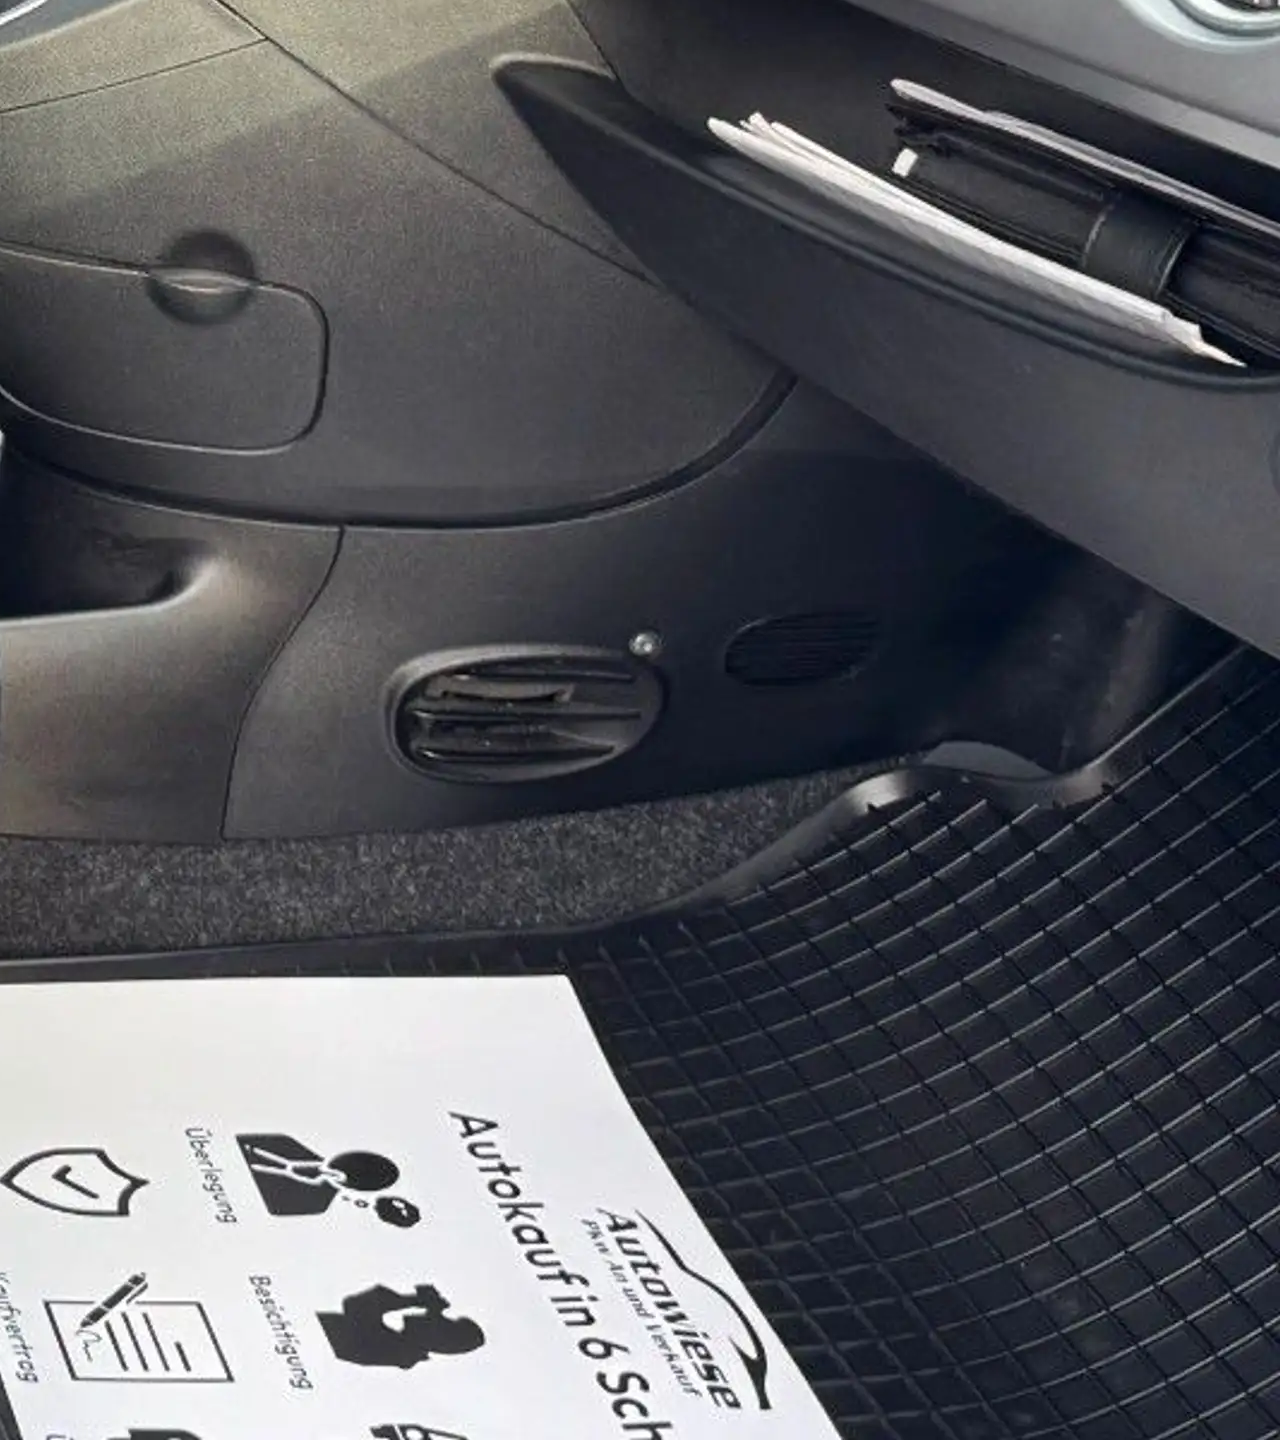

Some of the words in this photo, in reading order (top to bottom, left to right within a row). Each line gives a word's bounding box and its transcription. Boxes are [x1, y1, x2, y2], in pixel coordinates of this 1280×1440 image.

[185, 1124, 238, 1224] Überlegung
[448, 1110, 591, 1288] Autokauf
[550, 1294, 599, 1327] in
[577, 1337, 631, 1360] 6
[248, 1274, 314, 1391] Besichtigung
[596, 1207, 742, 1410] Autowiese
[622, 1287, 656, 1319] und
